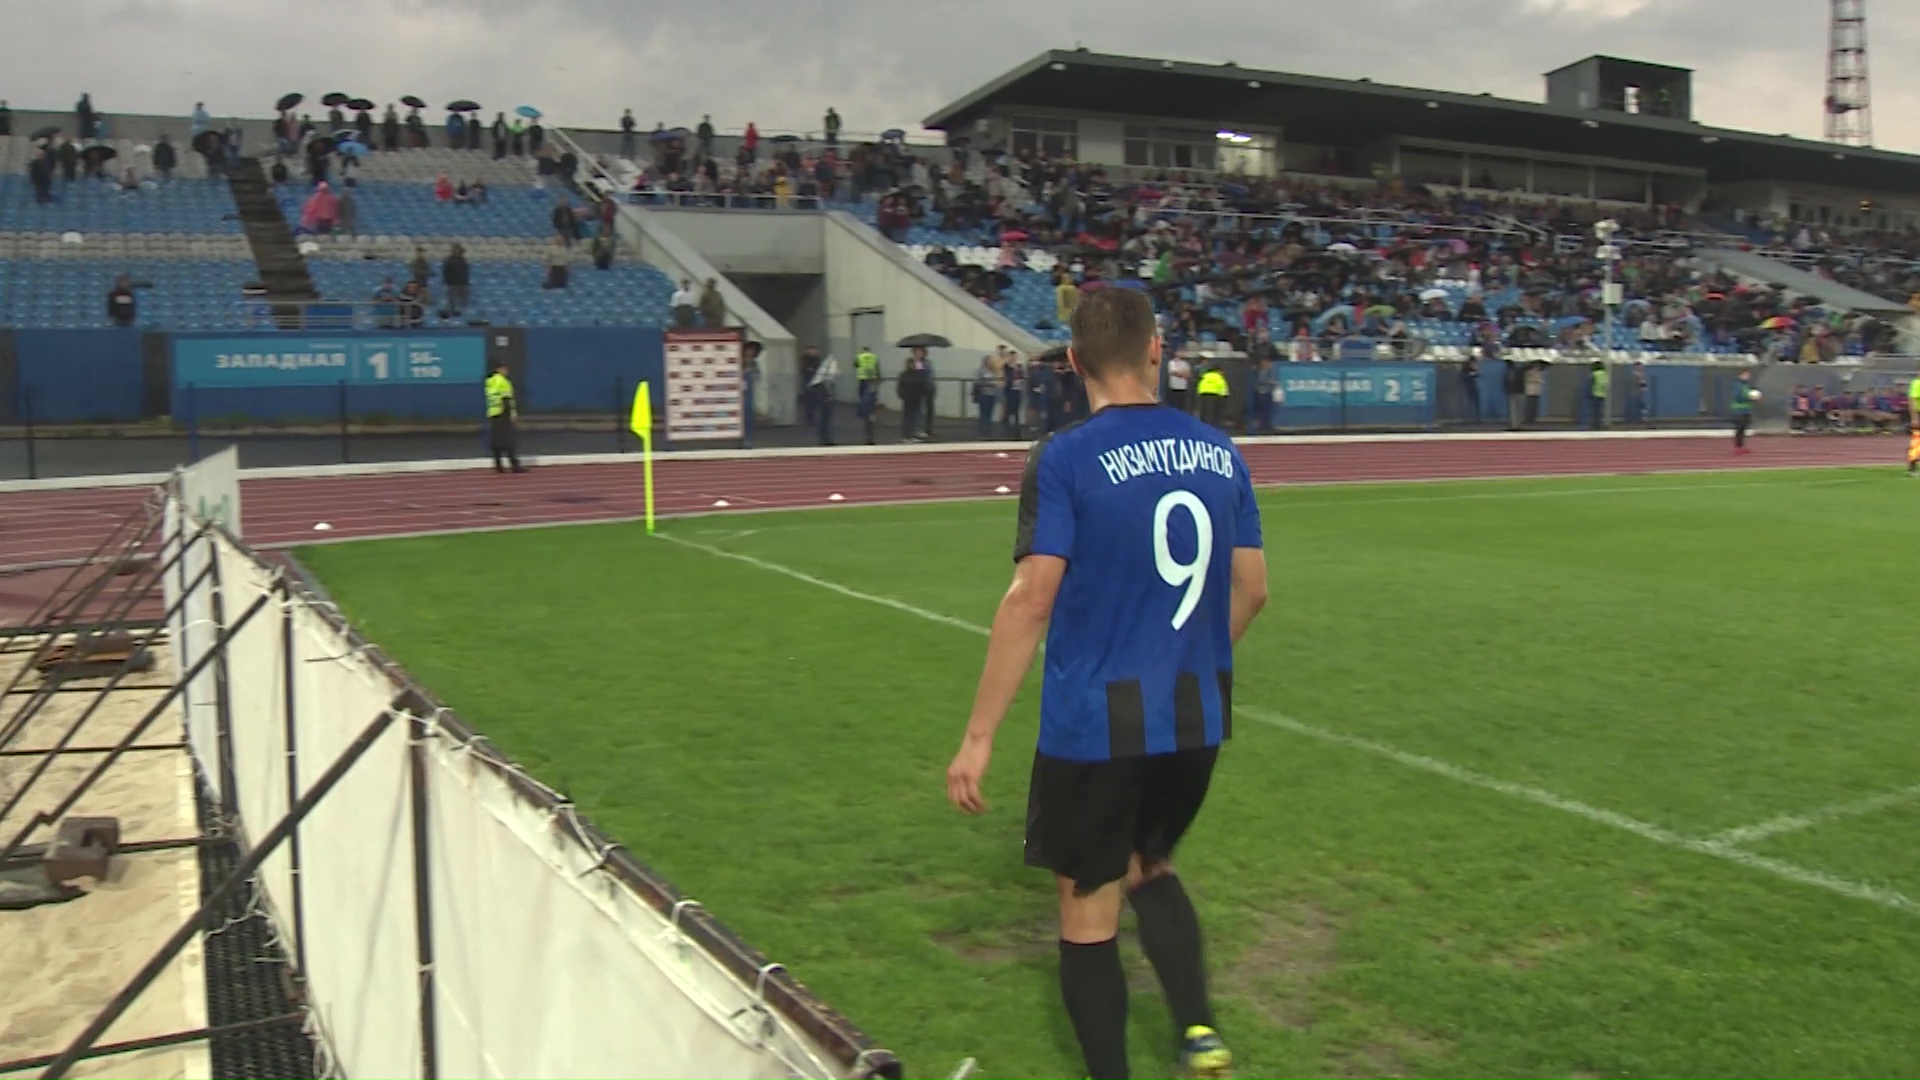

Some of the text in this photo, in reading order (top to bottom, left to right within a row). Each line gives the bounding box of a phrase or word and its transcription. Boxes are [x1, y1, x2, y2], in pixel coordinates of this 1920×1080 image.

[215, 353, 346, 370] ЗАПАДНАЯ
[367, 352, 389, 378] 1
[1384, 379, 1400, 402] 2
[1098, 438, 1233, 485] НИЗАМУТДИНОВ
[1153, 489, 1213, 631] 9
